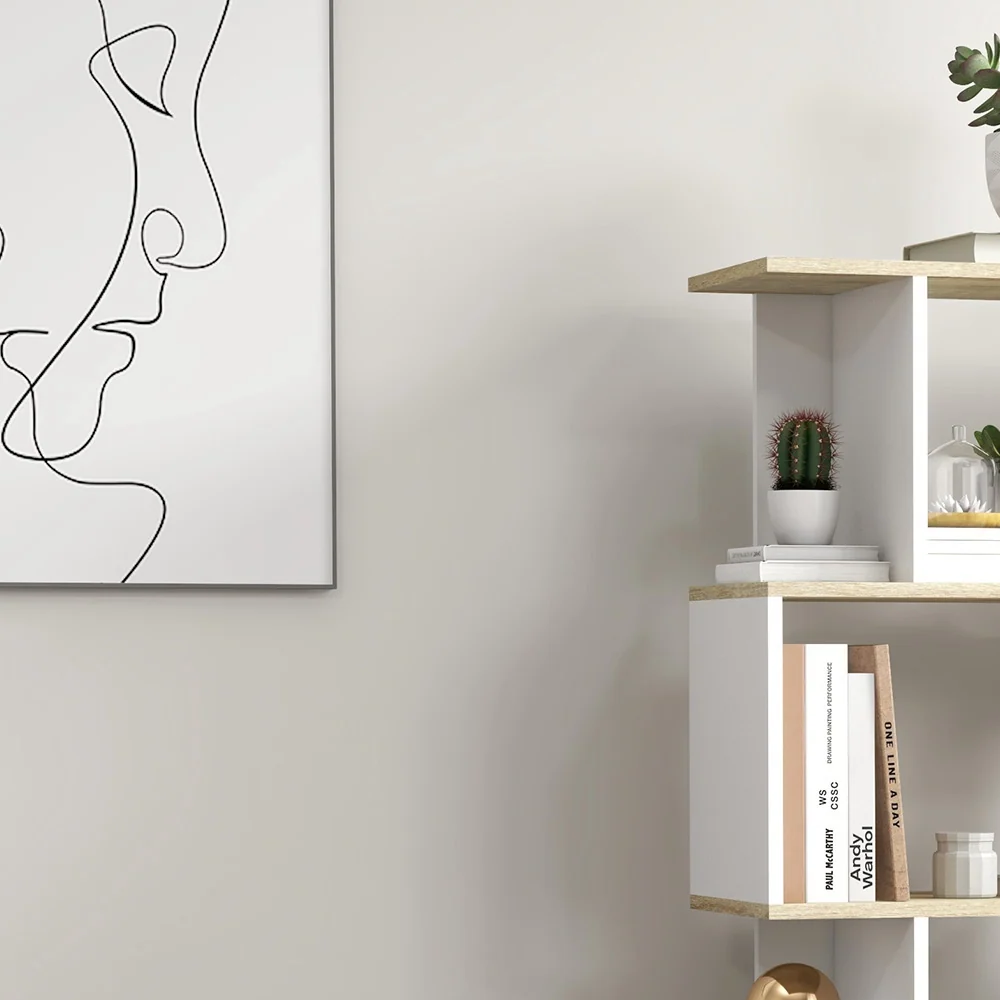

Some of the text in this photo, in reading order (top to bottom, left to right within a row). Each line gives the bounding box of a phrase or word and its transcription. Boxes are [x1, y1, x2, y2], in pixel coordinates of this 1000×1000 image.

[819, 790, 827, 805] WS
[830, 782, 839, 810] CSSC
[884, 722, 901, 829] ONE LINE A DAY
[825, 828, 834, 890] PAUL McCARTHY
[850, 833, 864, 881] Andy
[861, 826, 873, 889] Warhol
